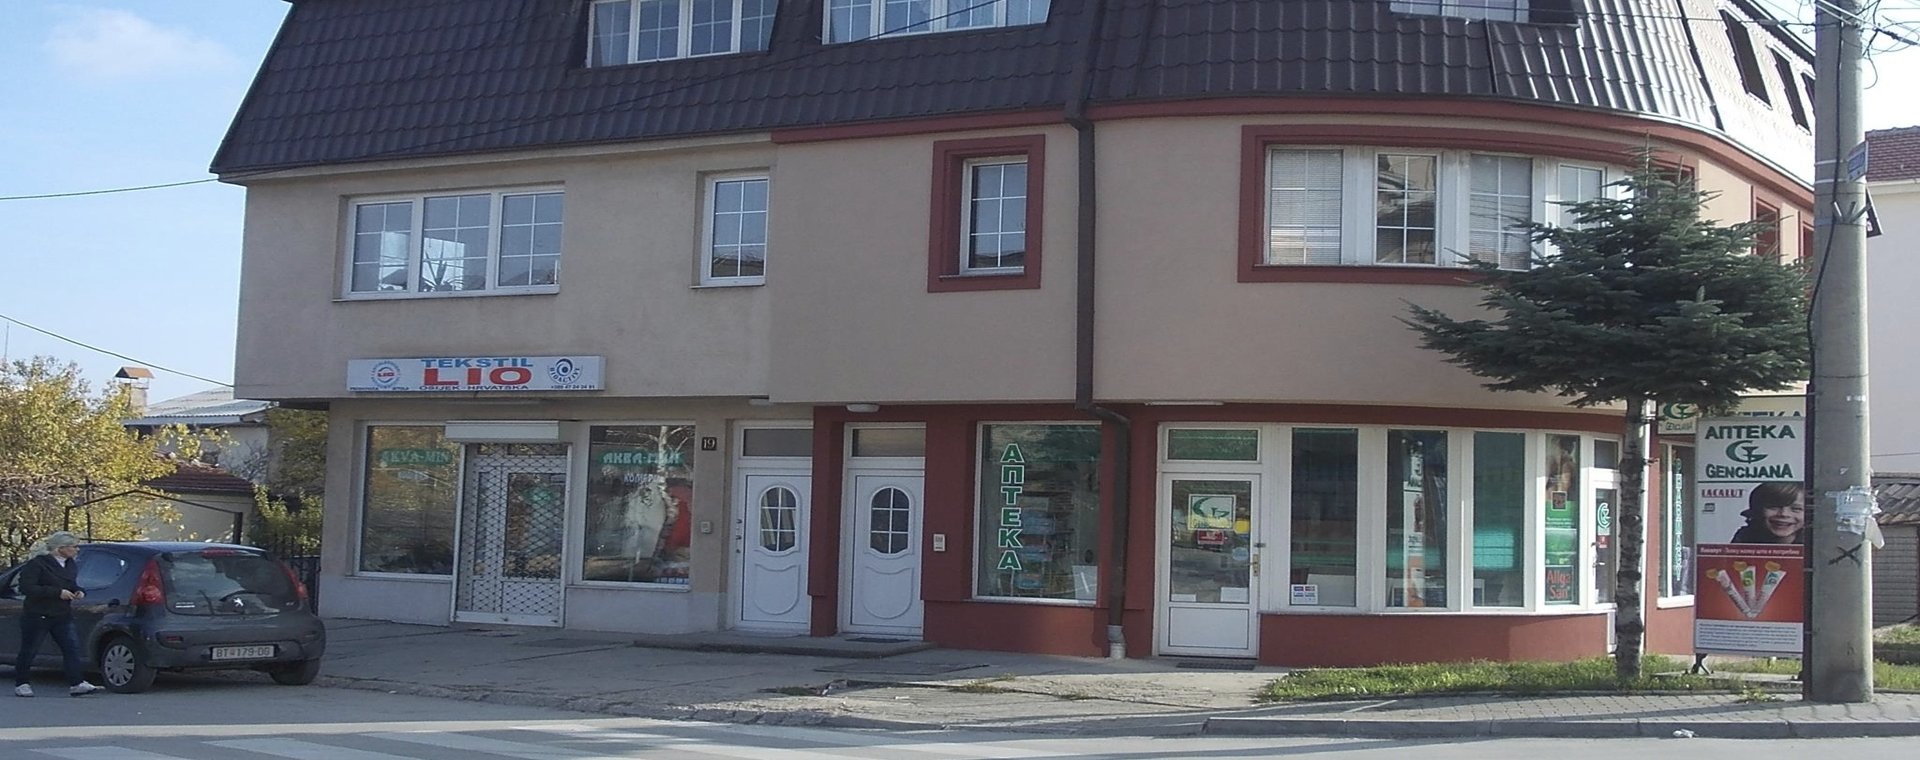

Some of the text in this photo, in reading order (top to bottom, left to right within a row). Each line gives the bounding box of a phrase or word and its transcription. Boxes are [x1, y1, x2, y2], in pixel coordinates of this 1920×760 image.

[420, 358, 534, 368] TEKSTIL
[423, 367, 533, 386] LIO
[1704, 425, 1796, 439] АПТЕКА
[703, 439, 715, 449] 19
[1705, 463, 1794, 479] GENCIJANA
[1701, 488, 1744, 498] LACALUT
[997, 443, 1025, 571] АПТЕКА
